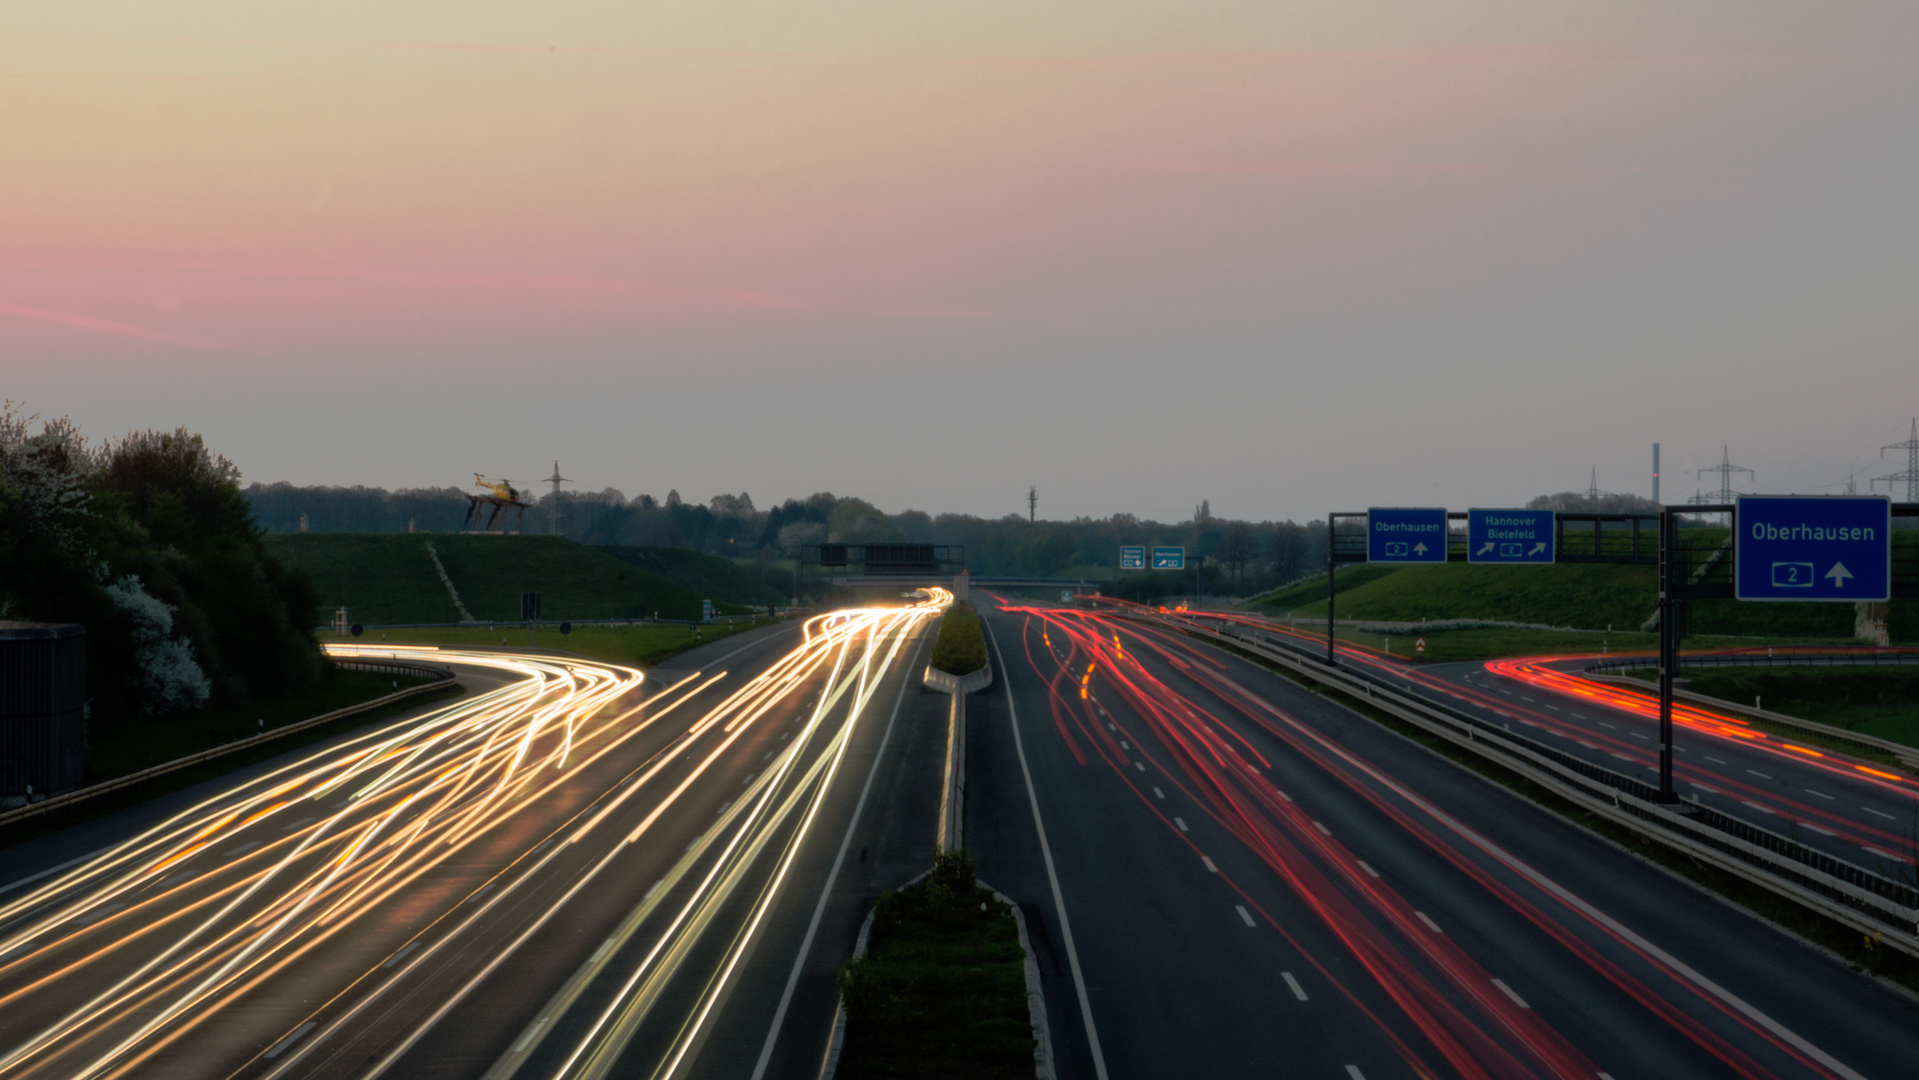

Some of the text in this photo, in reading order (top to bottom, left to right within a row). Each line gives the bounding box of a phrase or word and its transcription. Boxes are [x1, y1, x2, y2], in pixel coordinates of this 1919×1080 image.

[1485, 516, 1536, 526] Hannover
[1375, 521, 1440, 532] Oberhausen
[1752, 522, 1875, 541] Oberhausen
[1488, 529, 1535, 539] Bielefeld
[1394, 545, 1400, 554] 2
[1508, 545, 1515, 554] 2
[1788, 567, 1798, 582] 2
